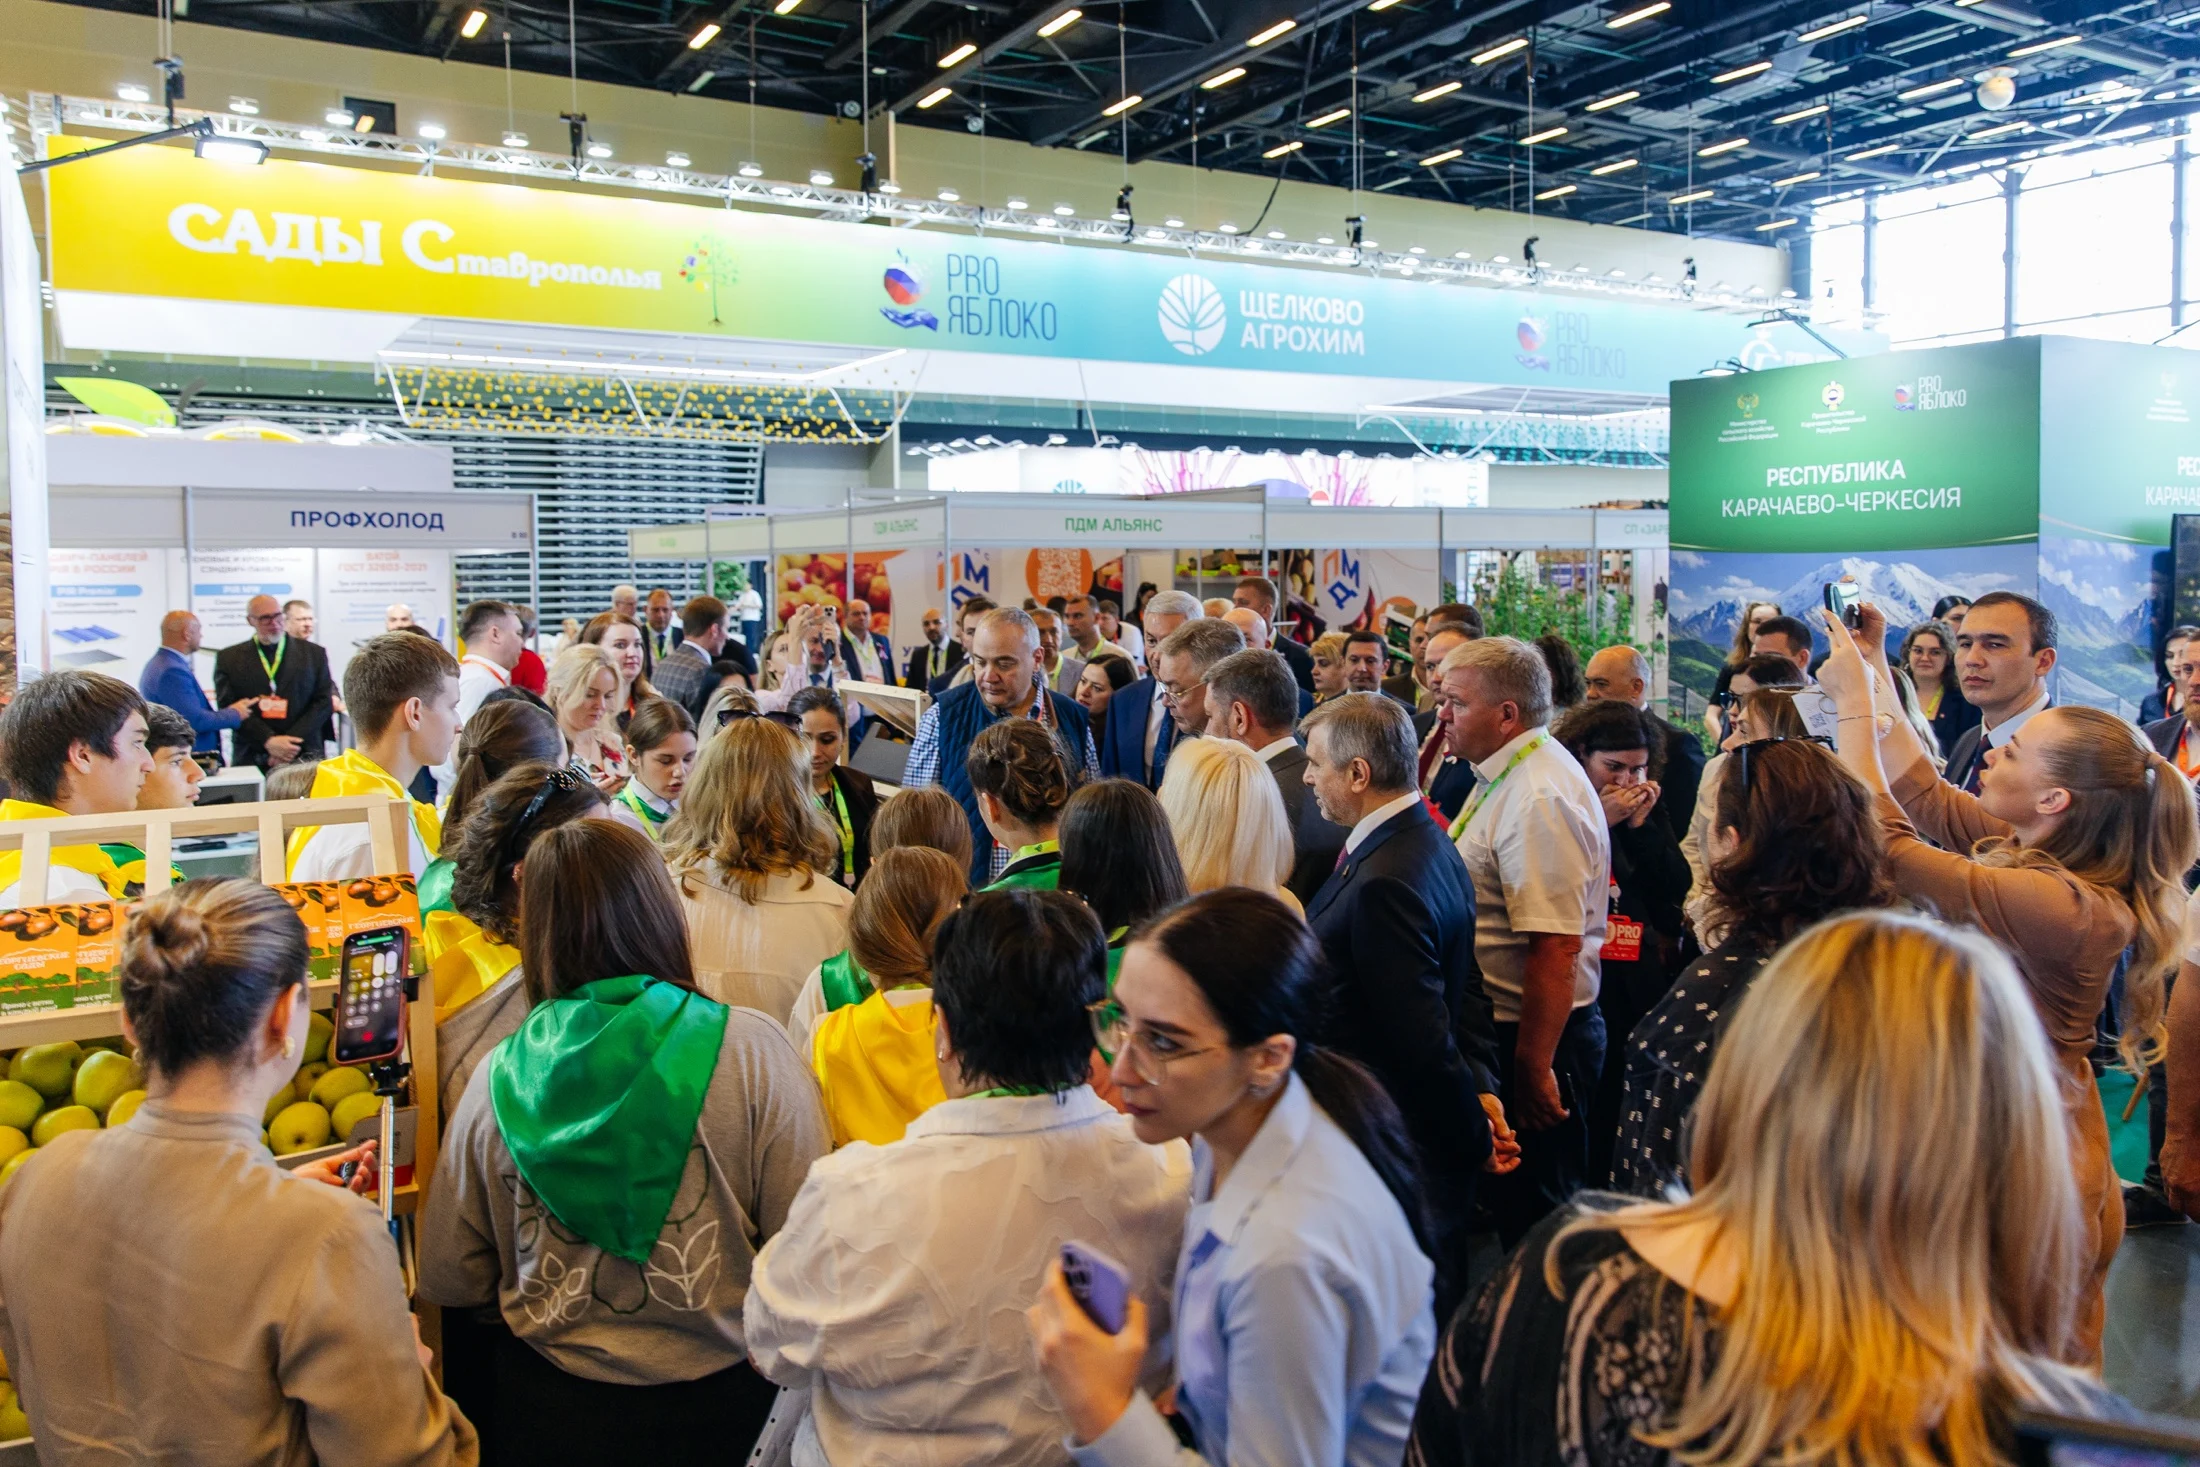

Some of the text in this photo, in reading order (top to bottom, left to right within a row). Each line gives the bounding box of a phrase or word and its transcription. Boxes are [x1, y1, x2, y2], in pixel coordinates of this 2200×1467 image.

[167, 202, 663, 290] САДЫ Ставрополья
[947, 253, 1000, 296] PRO
[947, 295, 1058, 341] ЯБЛОКО
[1239, 290, 1365, 326] ЩЕЛКОВО
[1240, 322, 1366, 356] АГРОХИМ
[1555, 311, 1590, 344] PRO
[1555, 344, 1627, 379] ЯБЛОКО
[1918, 375, 1942, 394] PRO
[1918, 388, 1967, 411] ЯБЛОКО
[1766, 459, 1907, 488] РЕСПУБЛИКА
[1721, 486, 1962, 519] КАРАЧАЕВО-ЧЕРКЕСИЯ
[290, 510, 445, 532] ПРОФХОЛОД
[1065, 517, 1163, 533] ПДМ АЛЬЯНС
[1616, 923, 1641, 939] PRO
